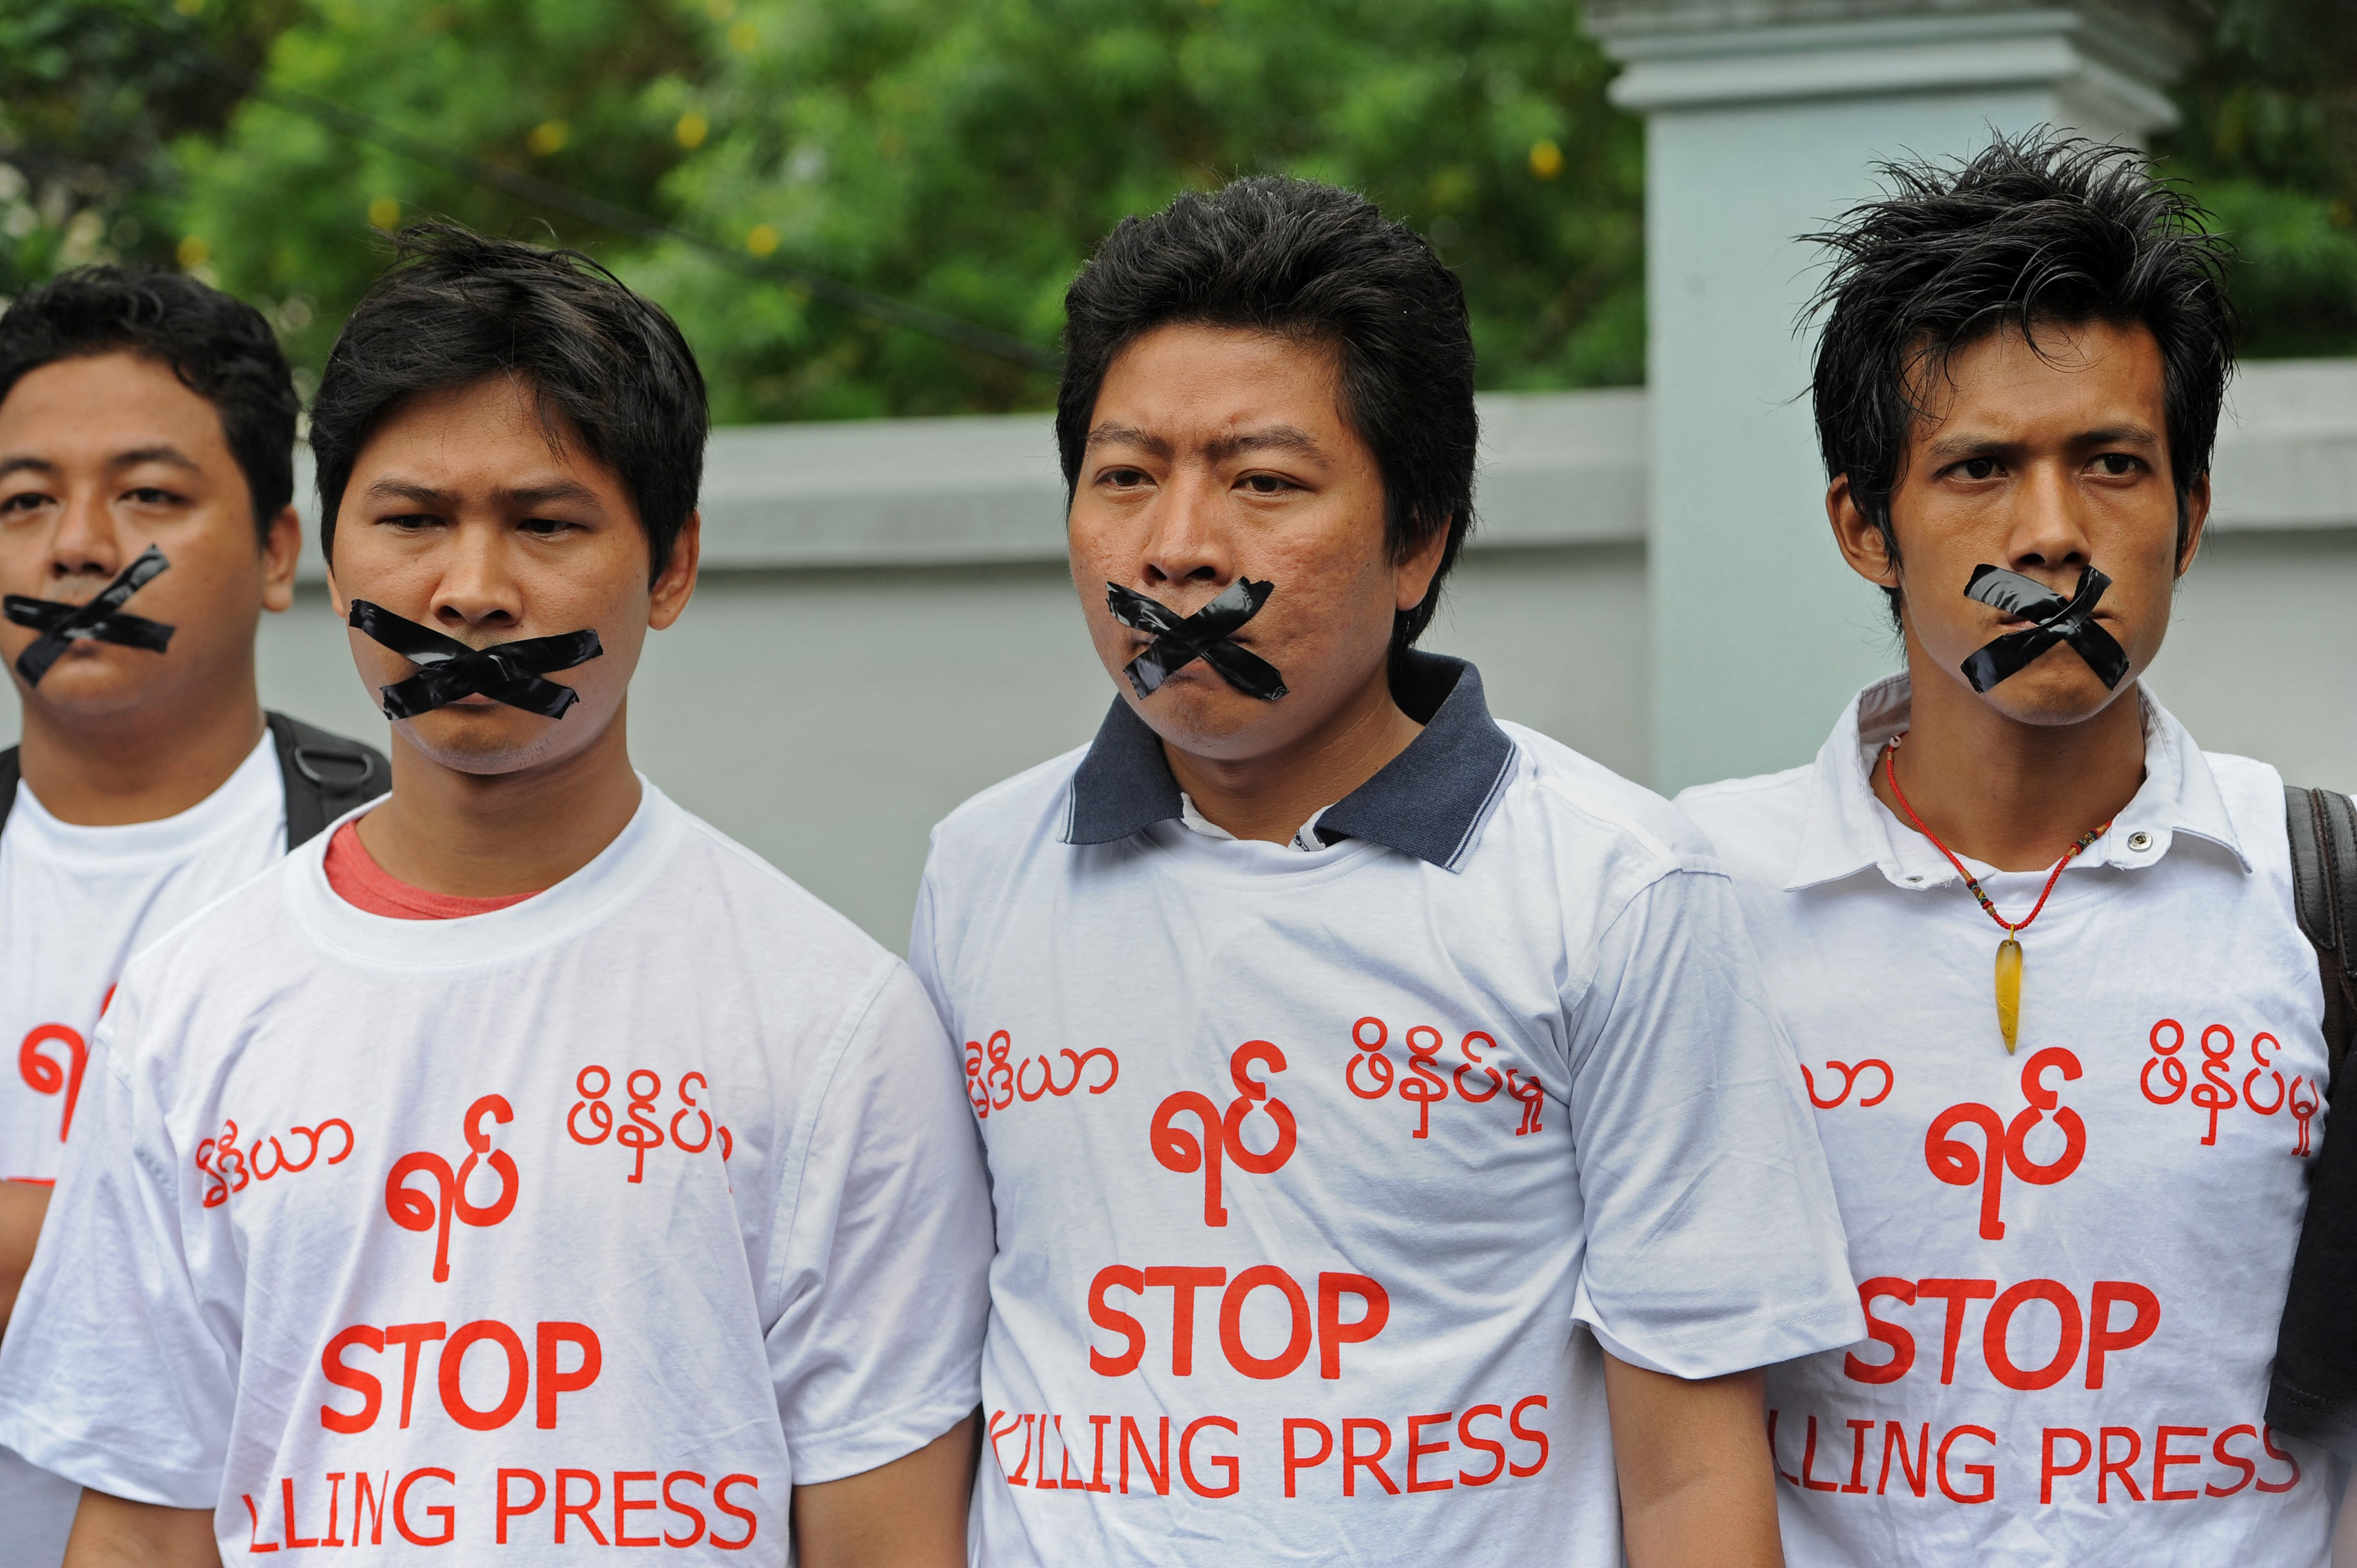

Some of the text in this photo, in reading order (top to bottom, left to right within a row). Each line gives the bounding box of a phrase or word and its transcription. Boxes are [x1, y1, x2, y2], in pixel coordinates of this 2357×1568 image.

[567, 1065, 733, 1184] ဖိနှိပ်
[1150, 1040, 1297, 1227] ရပ်
[1924, 1047, 2086, 1241] ရပ်
[385, 1094, 519, 1283] ရပ်
[320, 1319, 602, 1434] STOP
[1088, 1264, 1390, 1380] STOP
[1844, 1276, 2161, 1391] STOP
[989, 1395, 1549, 1499] KILLING PRESS
[1767, 1409, 2301, 1505] LLING PRESS
[241, 1466, 758, 1554] LLING PRESS
